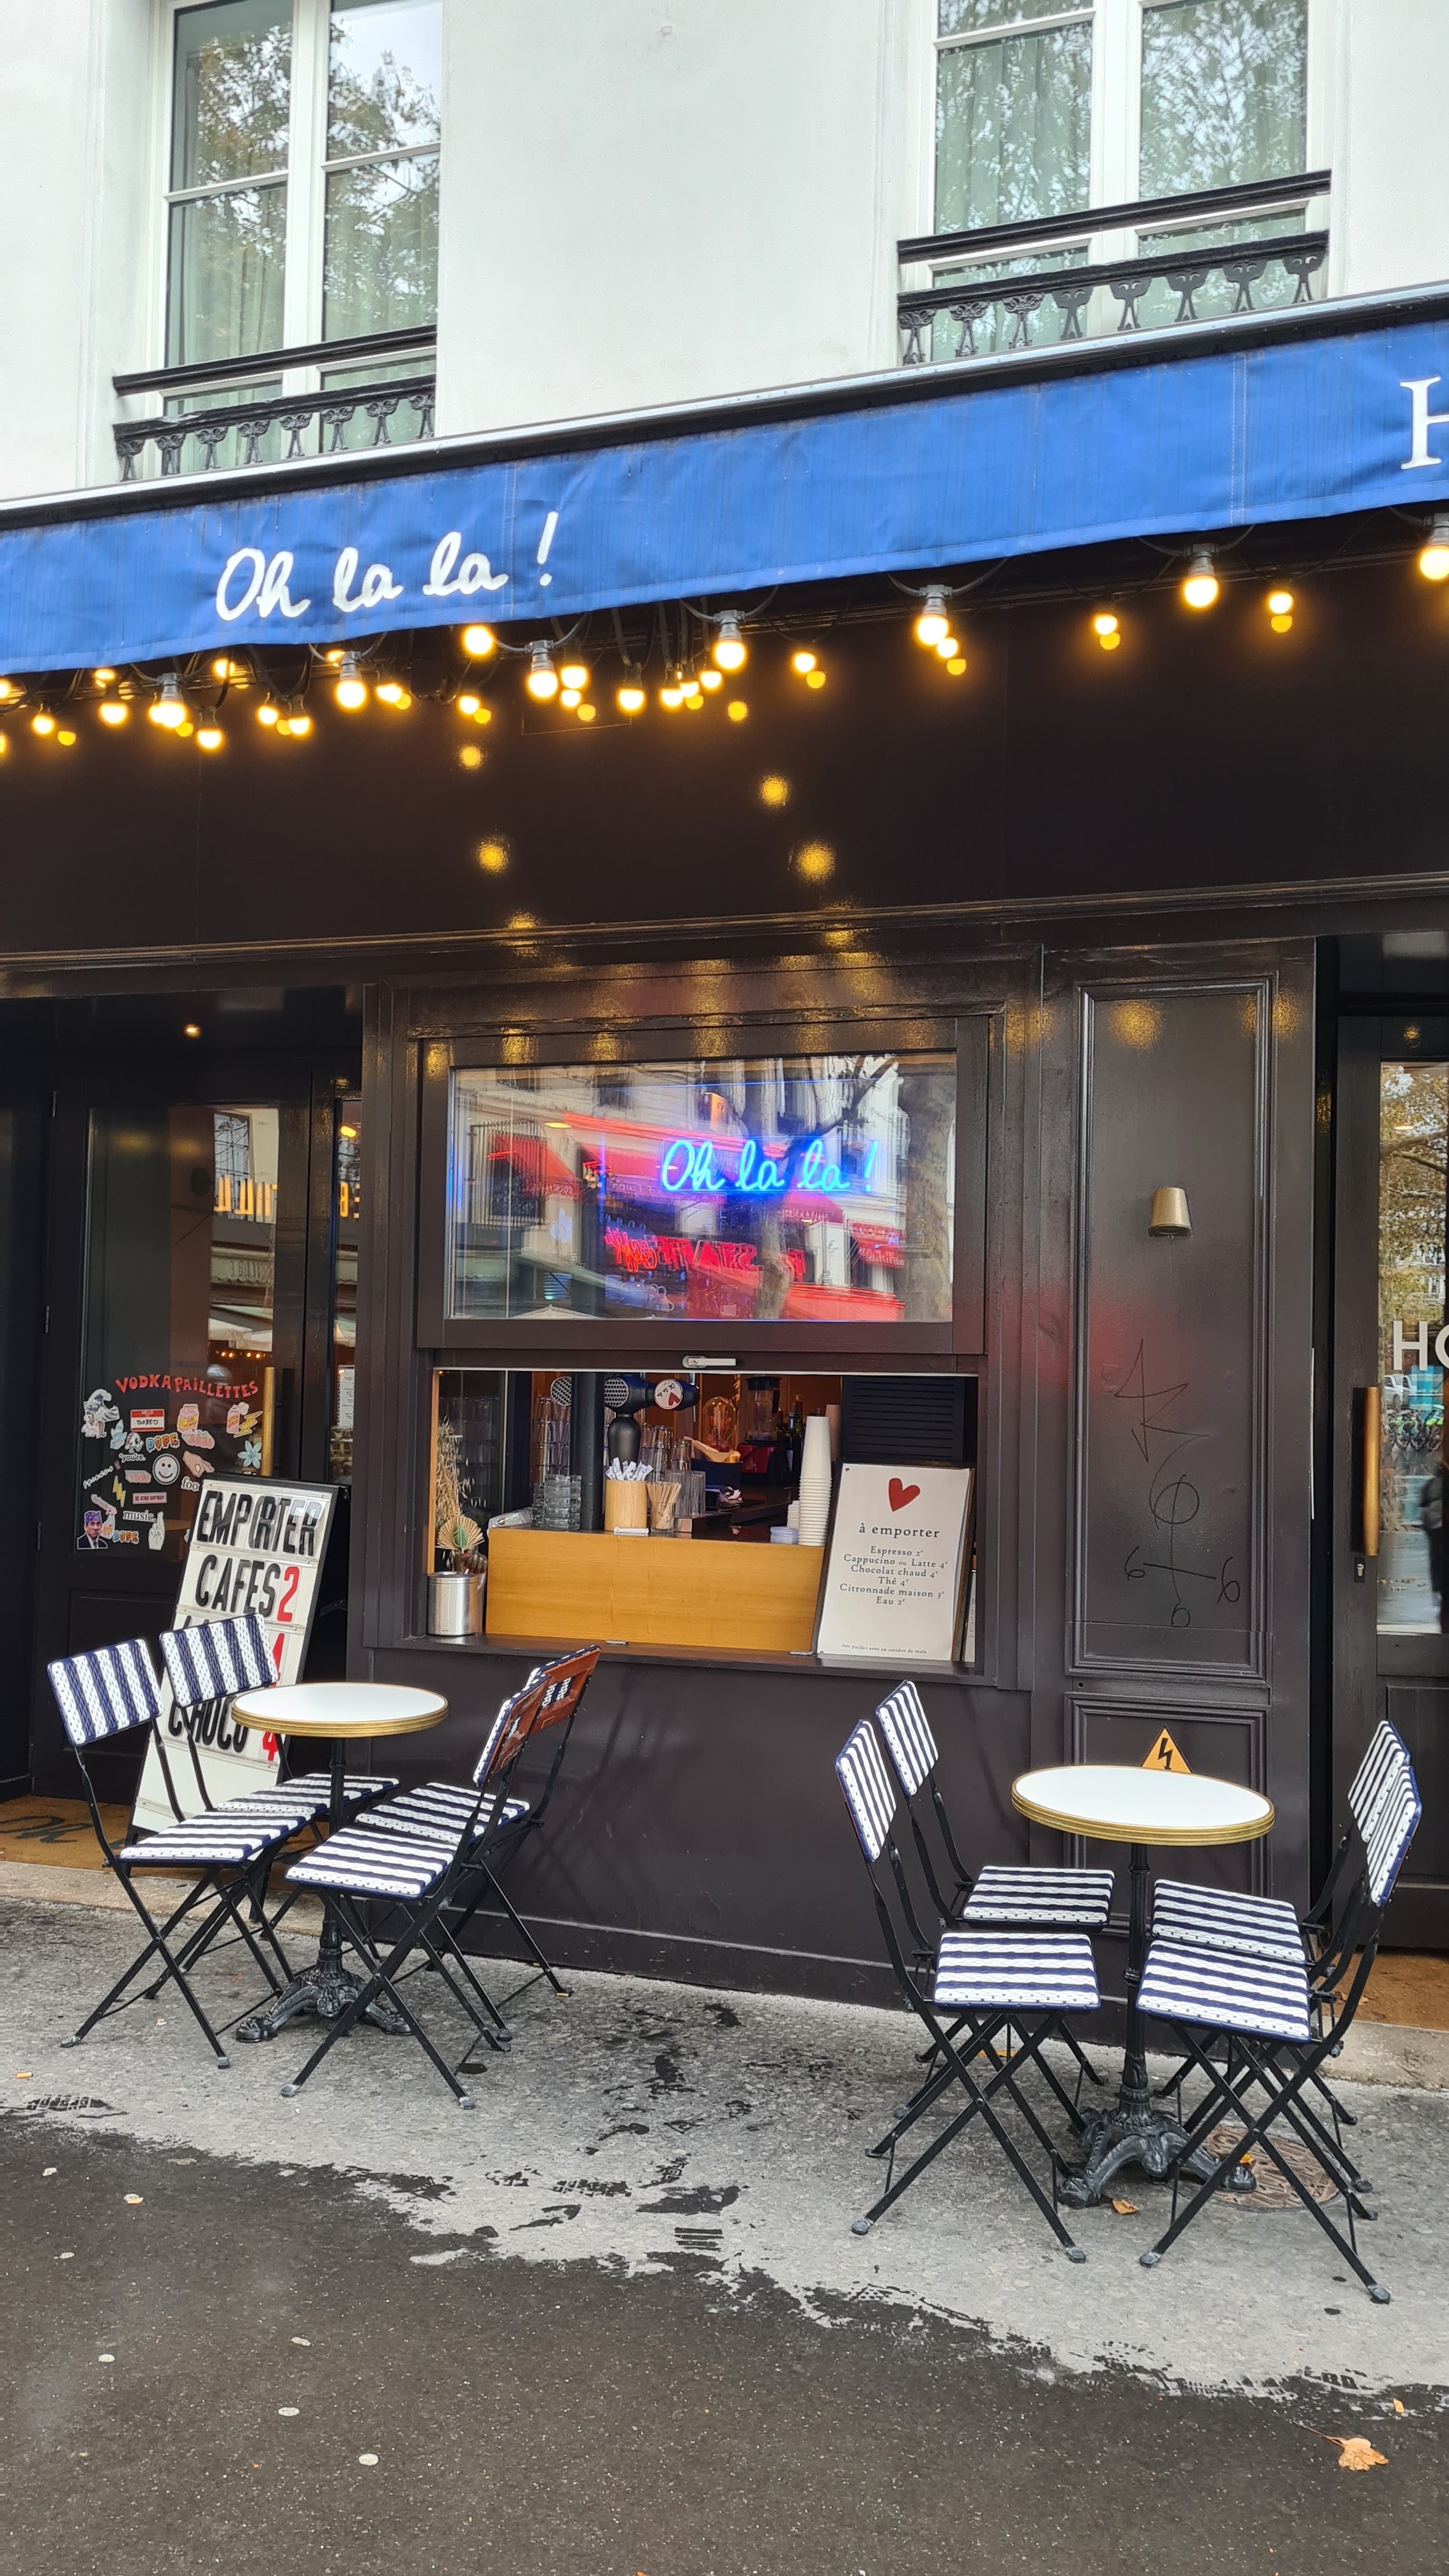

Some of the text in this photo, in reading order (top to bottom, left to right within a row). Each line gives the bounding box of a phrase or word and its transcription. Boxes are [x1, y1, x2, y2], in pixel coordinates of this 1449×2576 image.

[215, 511, 558, 622] Oh la la !
[662, 1140, 878, 1192] Oh la la !
[1393, 1321, 1449, 1370] H
[115, 1374, 171, 1394] VODKA
[146, 1433, 180, 1452] DOPE
[123, 1510, 157, 1522] music.
[113, 1531, 139, 1544] DOPE
[859, 1522, 940, 1539] à emporter
[870, 1545, 912, 1557] Espresso
[843, 1553, 896, 1565] Cappucino
[911, 1558, 937, 1568] Latte
[851, 1564, 895, 1575] Chocolat
[898, 1567, 927, 1577] chaud
[878, 1576, 897, 1585] Thé
[195, 1554, 299, 1623] CAFES 2
[839, 1583, 895, 1595] Citronnade
[898, 1589, 933, 1598] maison
[876, 1596, 894, 1605] Eau
